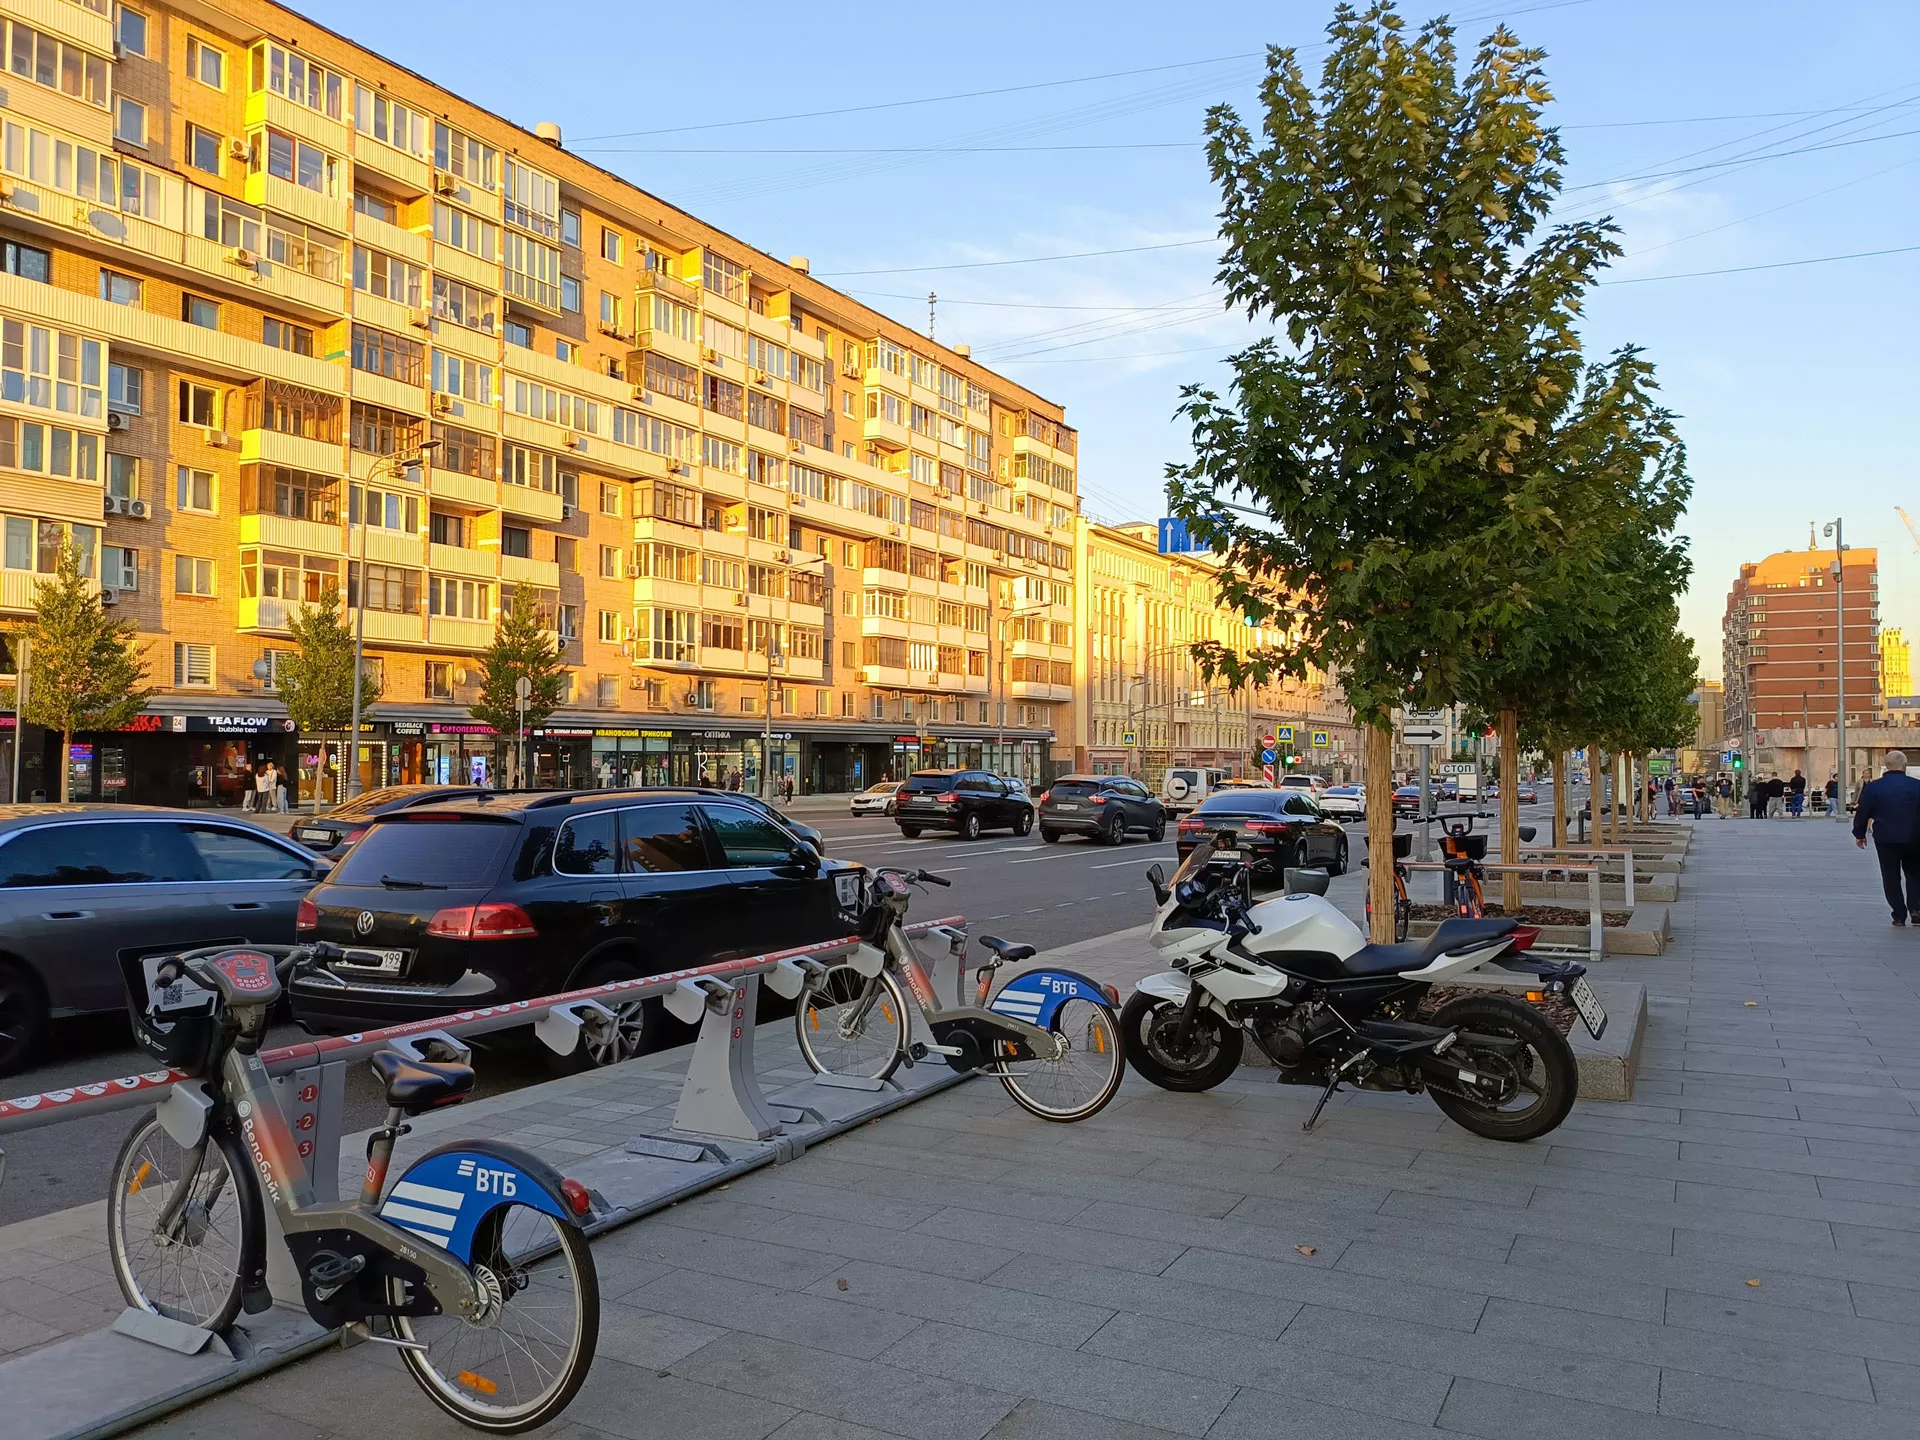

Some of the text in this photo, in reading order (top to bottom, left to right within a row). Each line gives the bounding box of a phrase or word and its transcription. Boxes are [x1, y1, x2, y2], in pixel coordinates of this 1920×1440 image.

[174, 718, 182, 726] 24
[207, 716, 268, 726] TEA FLOW
[596, 729, 673, 738] ИВАНОВСКИЙ ТРИКОТАЖ
[704, 731, 731, 739] ОПТИКА
[1443, 765, 1472, 773] СТОП
[103, 778, 125, 786] ТАБАК
[902, 964, 928, 1012] Велобайк
[1052, 980, 1078, 995] ВТБ
[306, 1088, 313, 1099] 1
[303, 1116, 311, 1128] 2
[301, 1143, 309, 1155] 3
[242, 1118, 281, 1204] Велобайк
[476, 1167, 517, 1197] ВТБ
